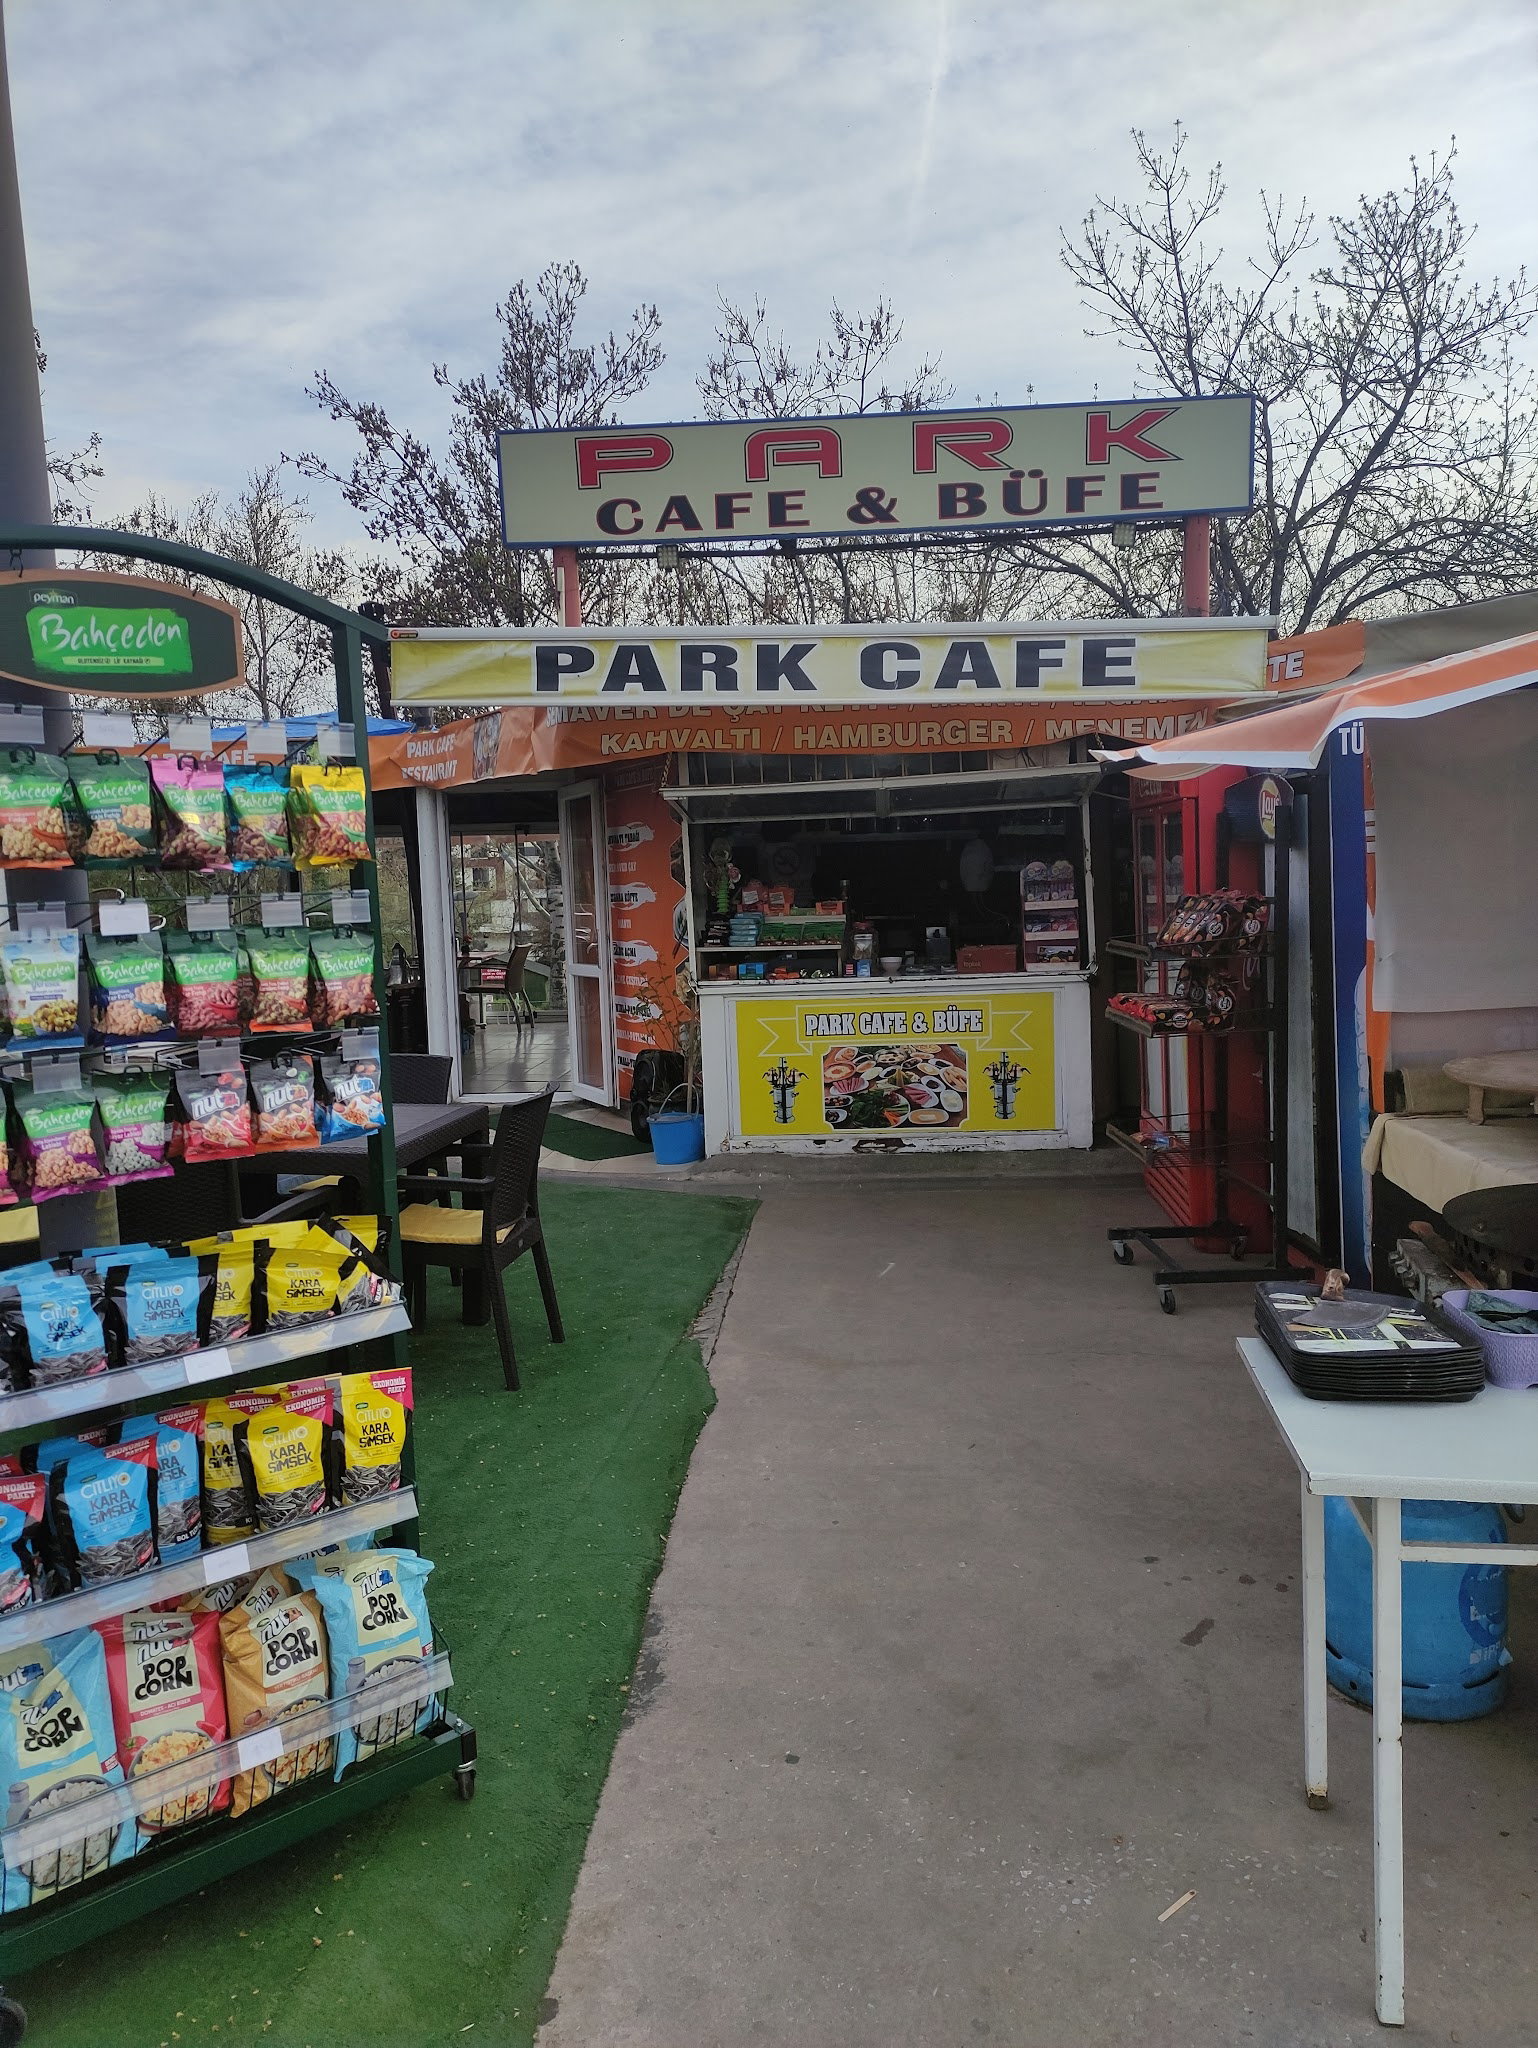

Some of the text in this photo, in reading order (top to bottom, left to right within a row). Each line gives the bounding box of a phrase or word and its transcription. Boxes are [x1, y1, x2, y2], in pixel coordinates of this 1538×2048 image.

[574, 407, 1184, 490] PARK
[596, 468, 1165, 536] CAFE & BÜFE
[34, 592, 75, 605] peyman
[38, 613, 182, 653] Bahçeden
[535, 637, 1138, 692] PARK CAFE
[406, 738, 435, 758] PARK
[601, 728, 761, 756] KAHVALTI
[793, 718, 1013, 750] HAMBURGER
[805, 1005, 983, 1036] PARK CAFE & BÜFE
[290, 1278, 321, 1288] KARA
[146, 1298, 181, 1312] KARA
[361, 1421, 390, 1437] KARA
[270, 1441, 307, 1461] KARA
[90, 1489, 130, 1513] KARA
[367, 1592, 397, 1616] POP
[362, 1607, 409, 1631] CORN
[267, 1626, 311, 1659] POP
[142, 1655, 187, 1683] POP
[266, 1640, 319, 1677] CORN
[134, 1671, 194, 1701] CORN
[24, 1715, 85, 1752] CORN
